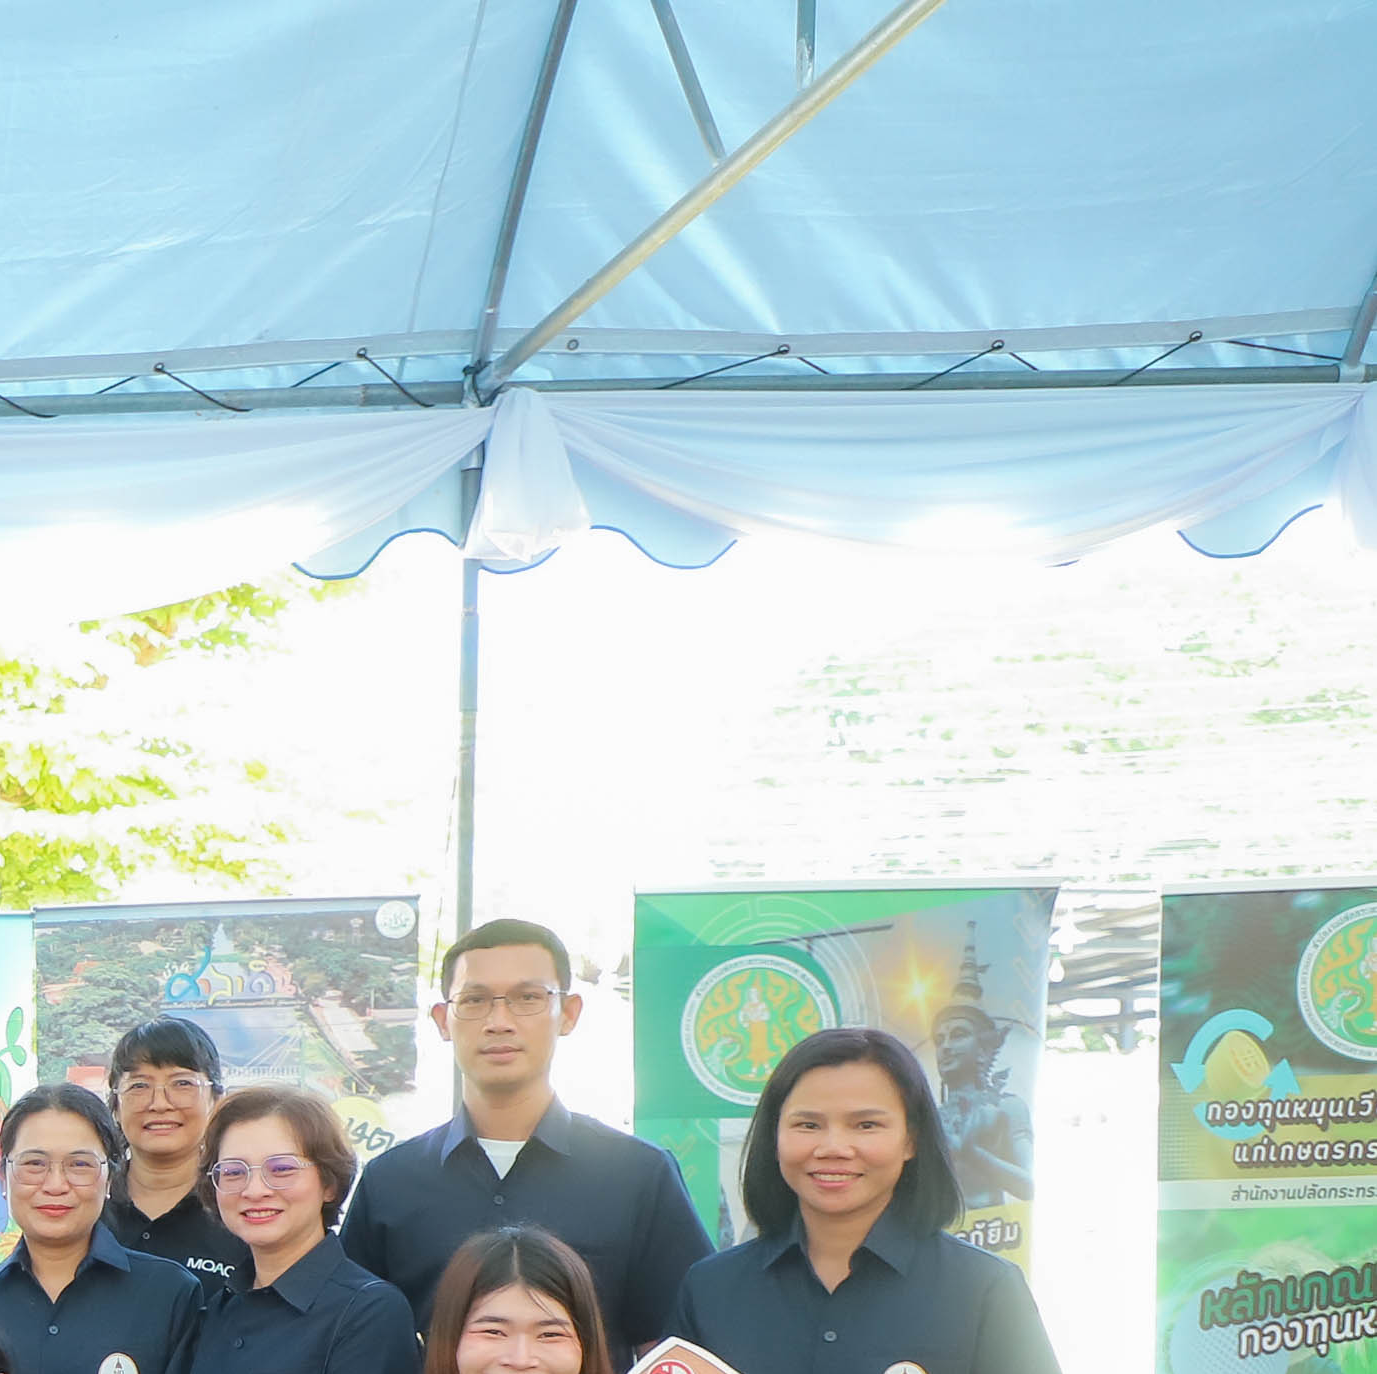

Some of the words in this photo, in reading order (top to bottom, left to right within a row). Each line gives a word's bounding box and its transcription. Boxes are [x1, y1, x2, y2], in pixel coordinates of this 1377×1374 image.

[1206, 1092, 1377, 1127] กองทุนหมุนเวี
[1231, 1184, 1377, 1202] สำนักงานปลัดกระทร
